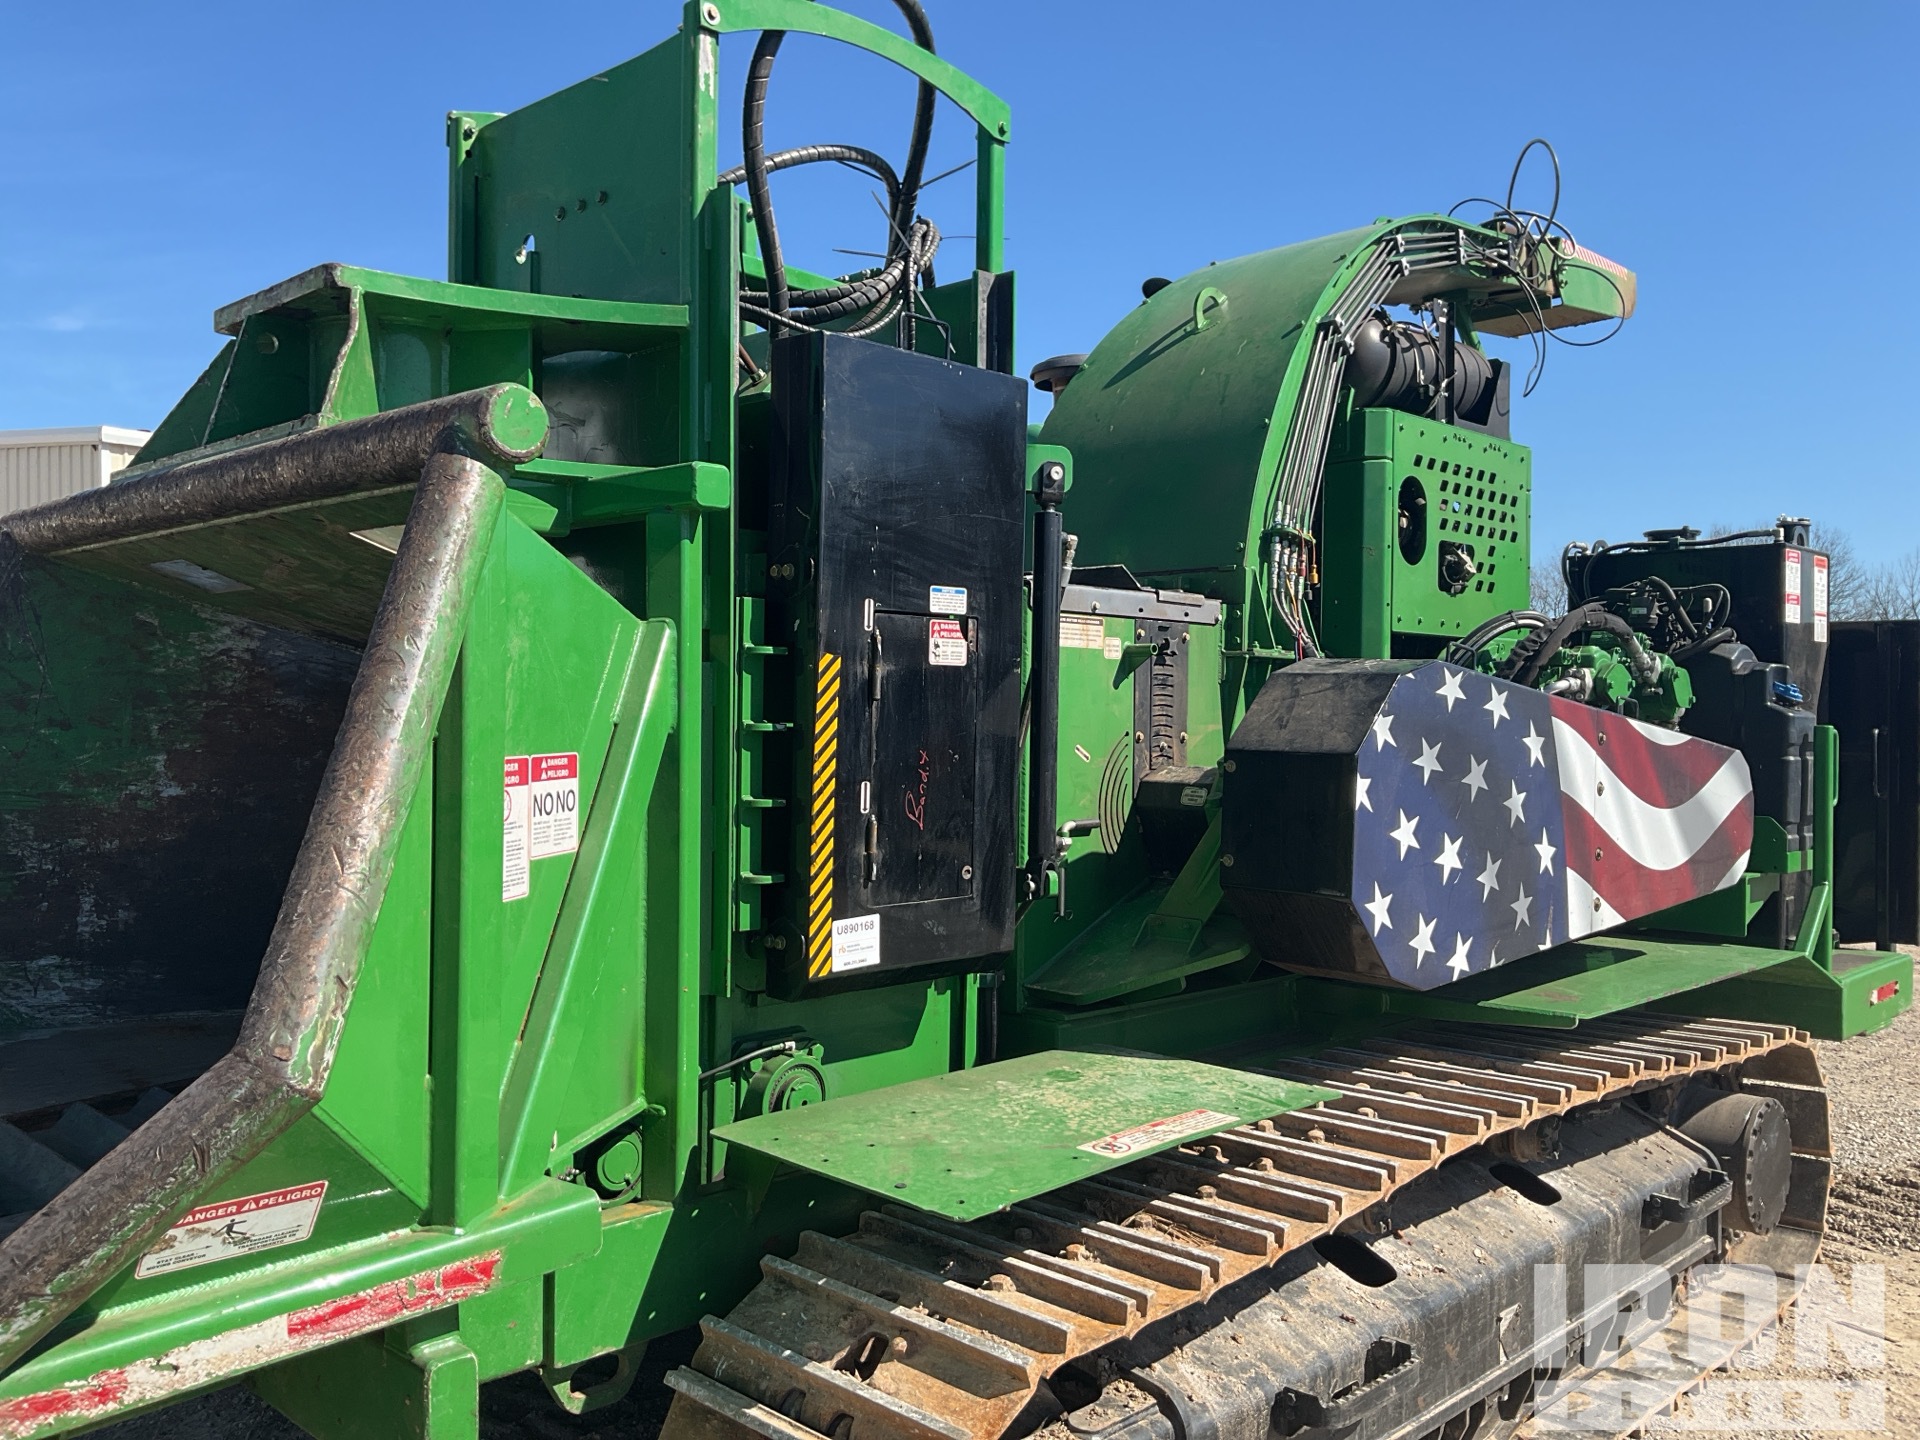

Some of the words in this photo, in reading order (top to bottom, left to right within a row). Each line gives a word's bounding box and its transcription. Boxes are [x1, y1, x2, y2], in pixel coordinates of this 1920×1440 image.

[940, 623, 961, 631] DANGE
[940, 631, 964, 639] PELIGR
[547, 757, 568, 766] DANGER
[547, 769, 569, 778] PELIGRO
[533, 792, 554, 818] NO
[556, 789, 576, 814] NO
[836, 920, 875, 935] U890168
[258, 1187, 322, 1208] PELIGRO
[146, 1262, 171, 1271] MOVING
[172, 1253, 207, 1265] CONVEYOR
[156, 1257, 173, 1265] STAY
